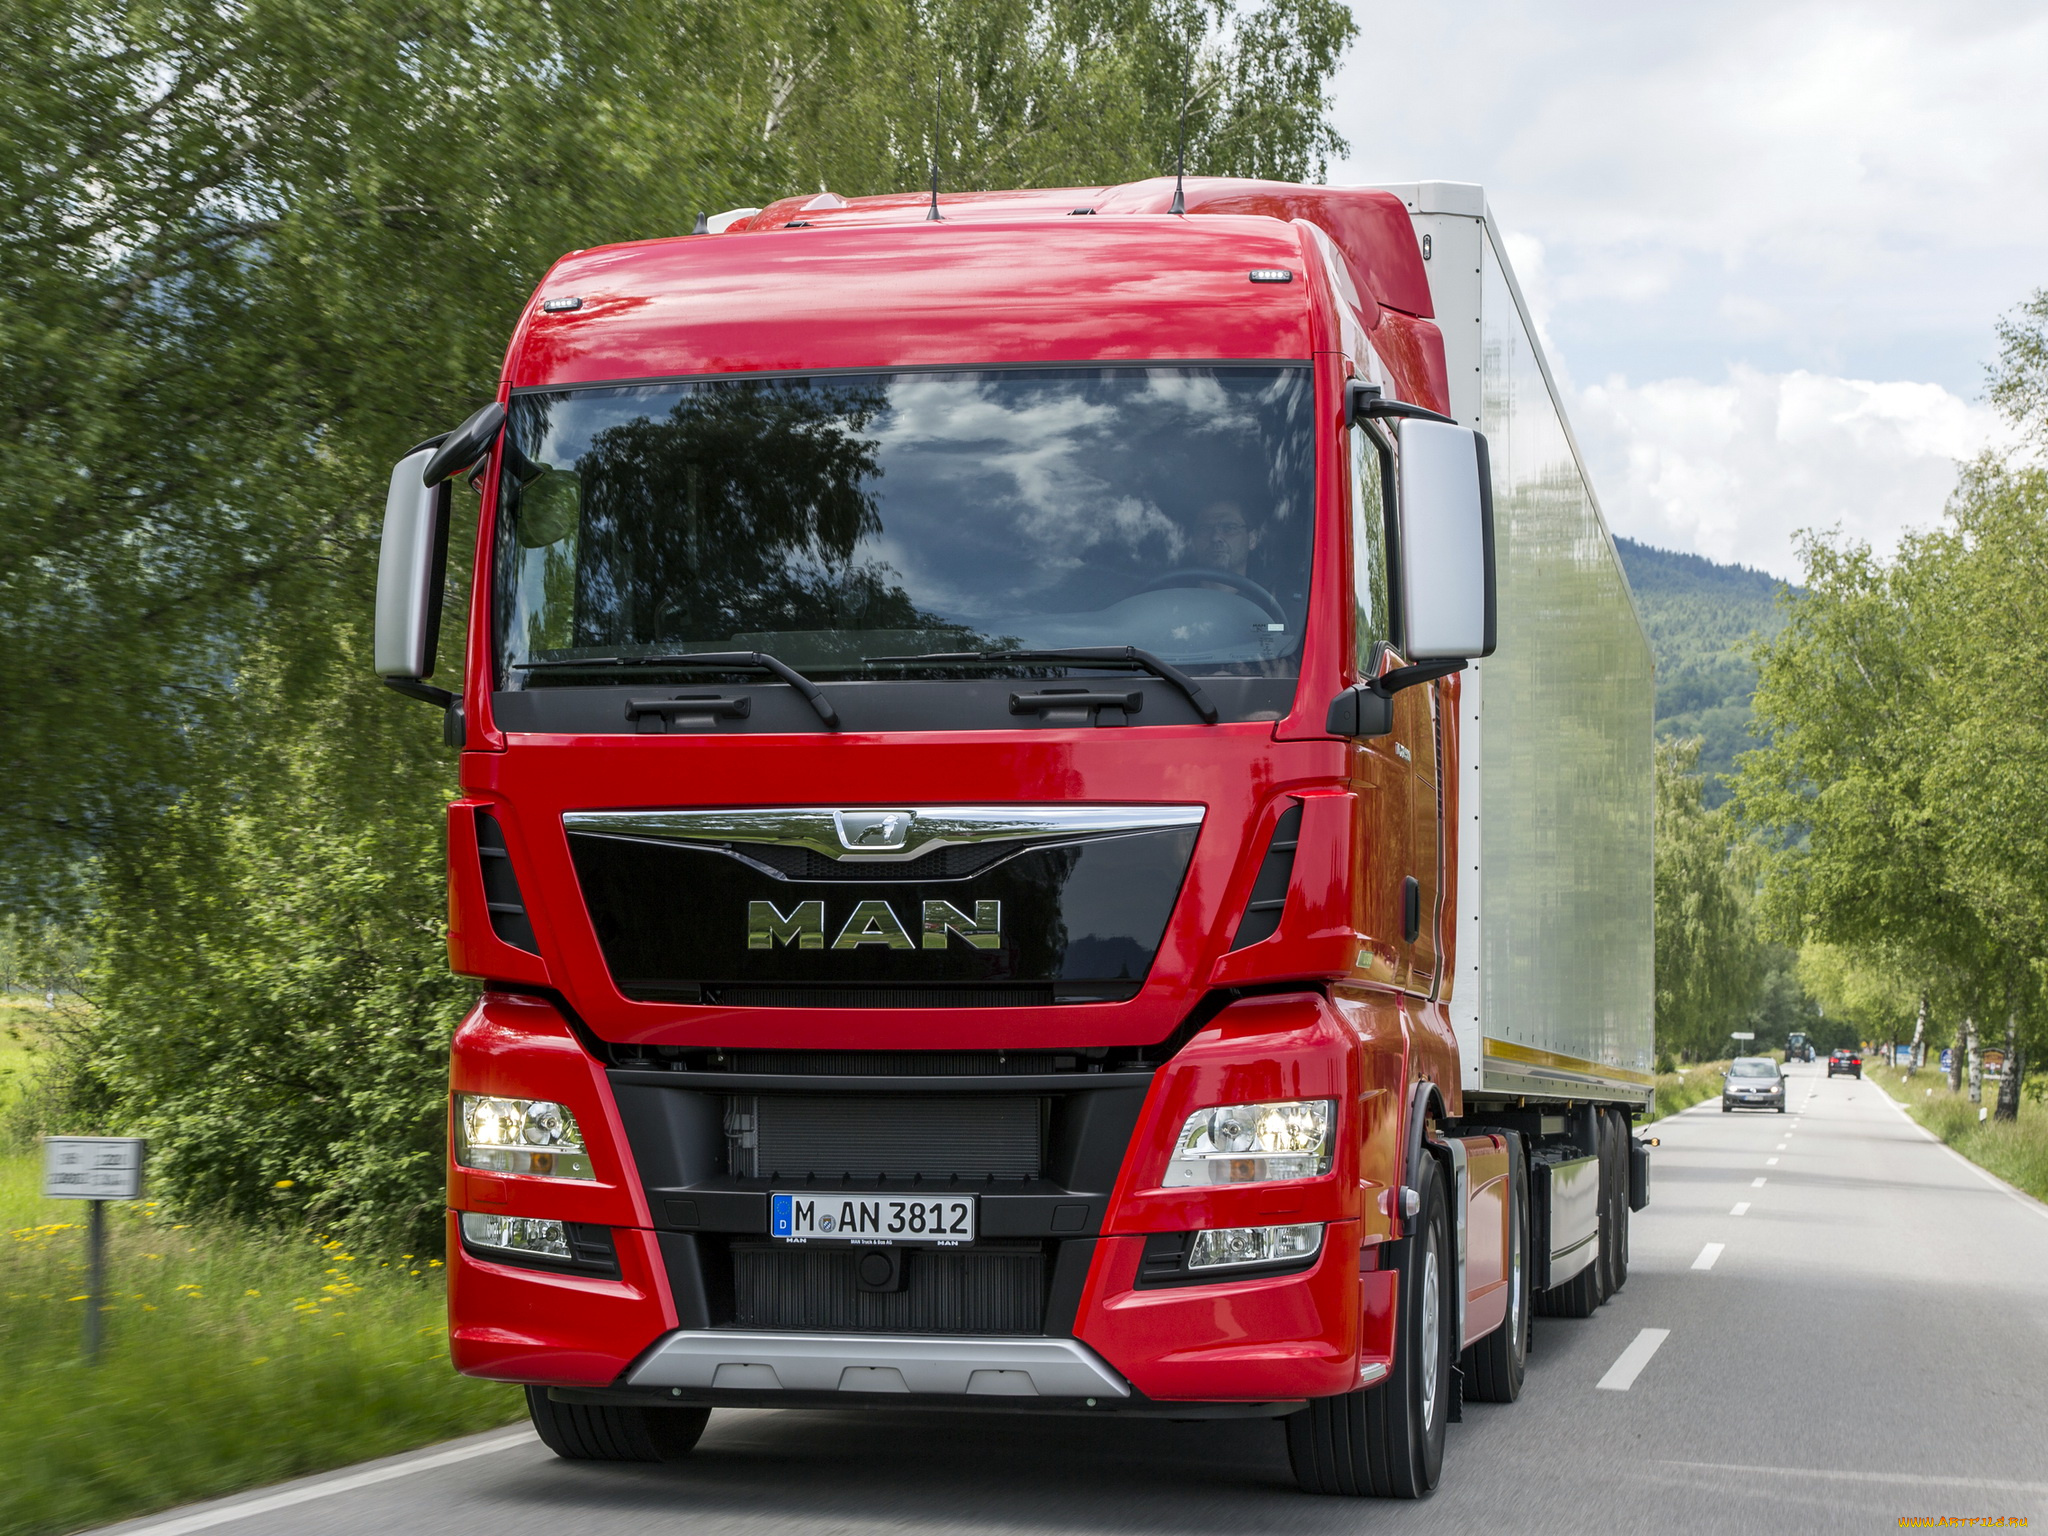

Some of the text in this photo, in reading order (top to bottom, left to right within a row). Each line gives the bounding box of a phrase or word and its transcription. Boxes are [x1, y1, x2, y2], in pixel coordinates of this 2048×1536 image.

[748, 900, 1000, 949] MAN
[779, 1200, 968, 1234] D M AN 3812
